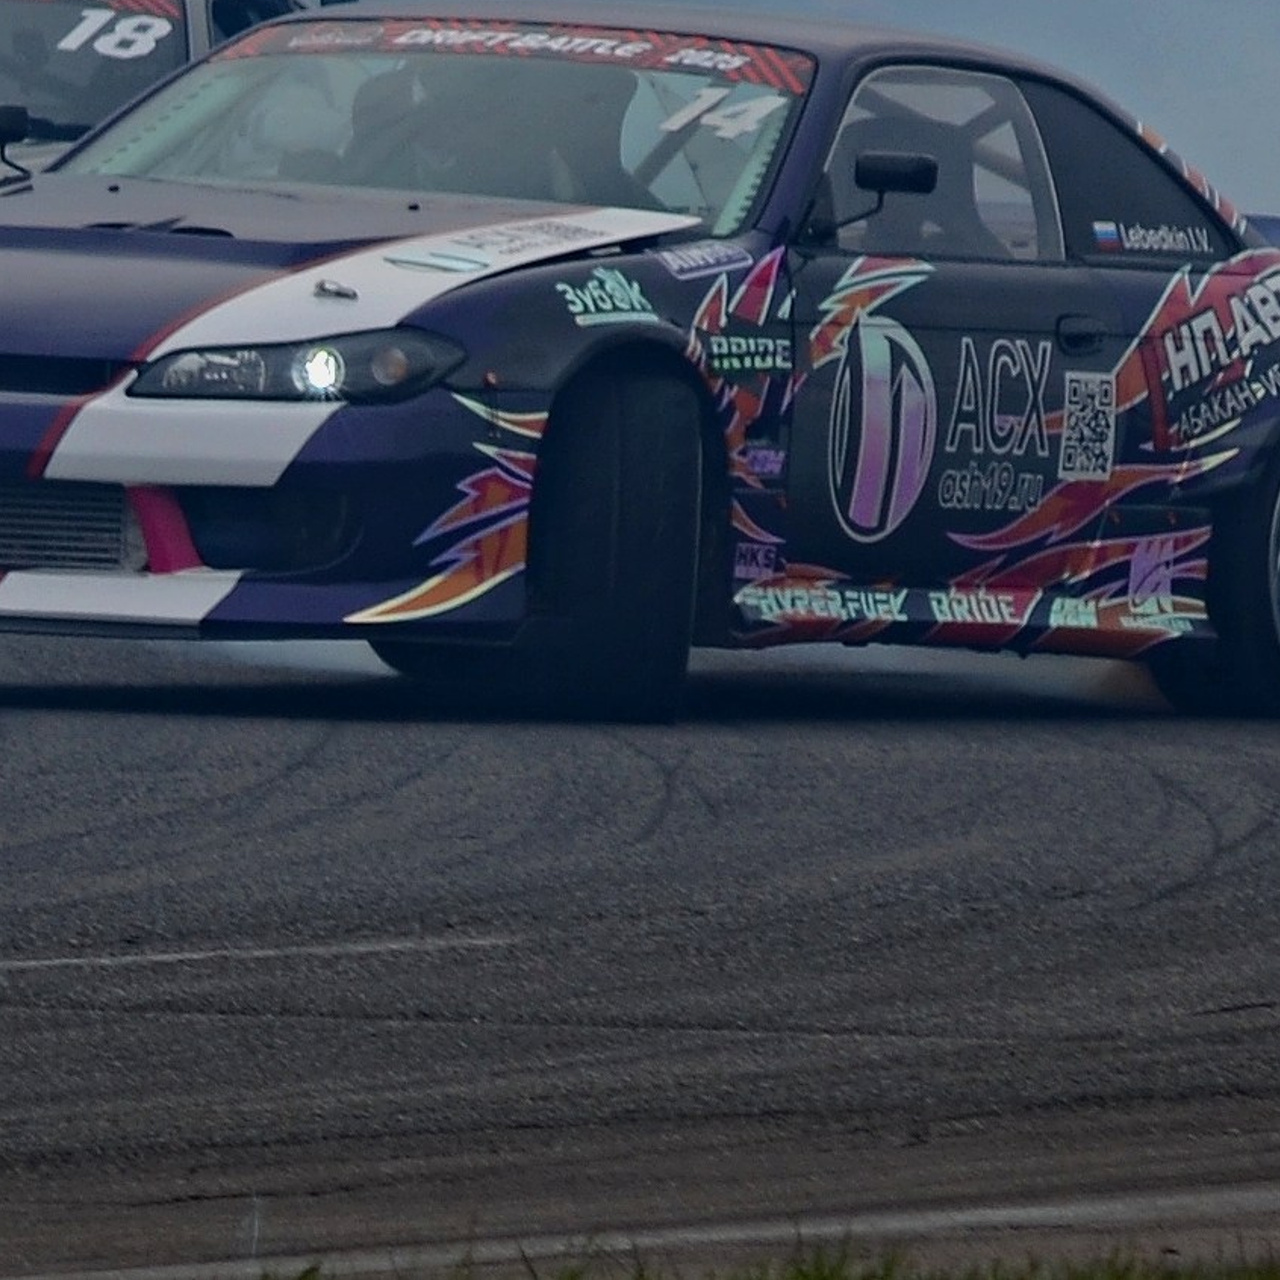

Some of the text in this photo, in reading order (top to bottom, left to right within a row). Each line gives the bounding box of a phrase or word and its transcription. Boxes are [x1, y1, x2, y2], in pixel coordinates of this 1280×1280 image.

[57, 8, 172, 60] 18
[392, 29, 517, 46] DRIFT
[507, 33, 653, 58] BATTLE
[660, 86, 789, 139] 14
[1164, 309, 1230, 391] НП
[1180, 380, 1257, 439] АБАКАН
[928, 589, 1019, 624] BRIDE
